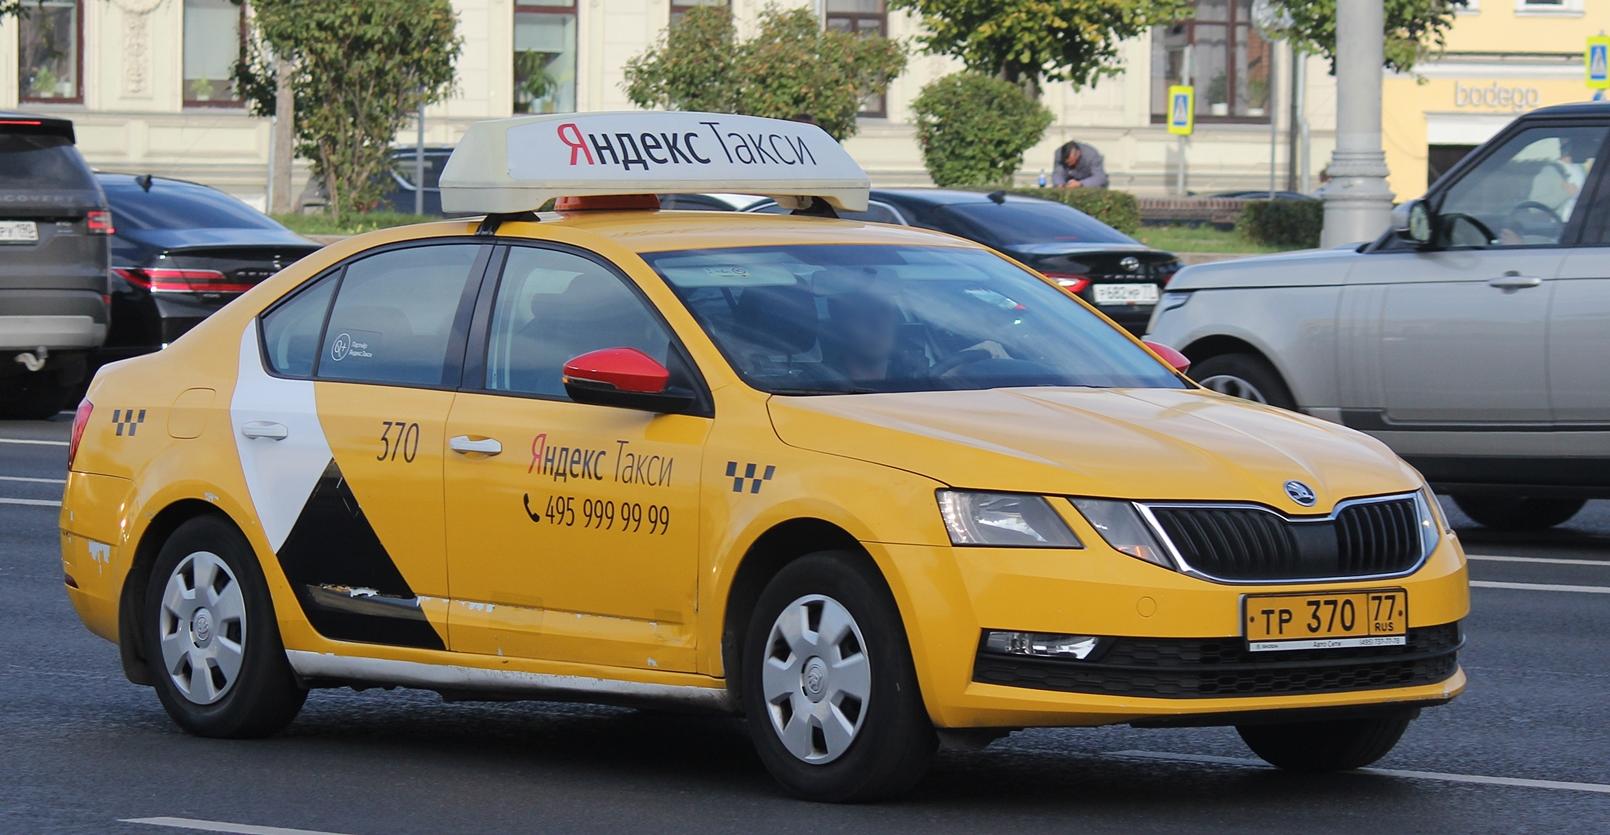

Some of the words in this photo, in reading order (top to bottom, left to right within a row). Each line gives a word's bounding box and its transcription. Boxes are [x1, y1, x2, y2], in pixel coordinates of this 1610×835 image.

[557, 123, 711, 171] Яндекс
[700, 121, 817, 166] Такси
[0, 194, 75, 203] COVERY
[376, 421, 420, 464] 370
[528, 433, 607, 483] Яндекс
[614, 440, 674, 488] Такси
[545, 495, 575, 527] 495
[583, 498, 615, 531] 999
[621, 502, 643, 533] 99
[648, 504, 670, 536] 99
[1306, 599, 1356, 633] 370
[1371, 595, 1396, 621] 77
[1374, 622, 1395, 632] RUS
